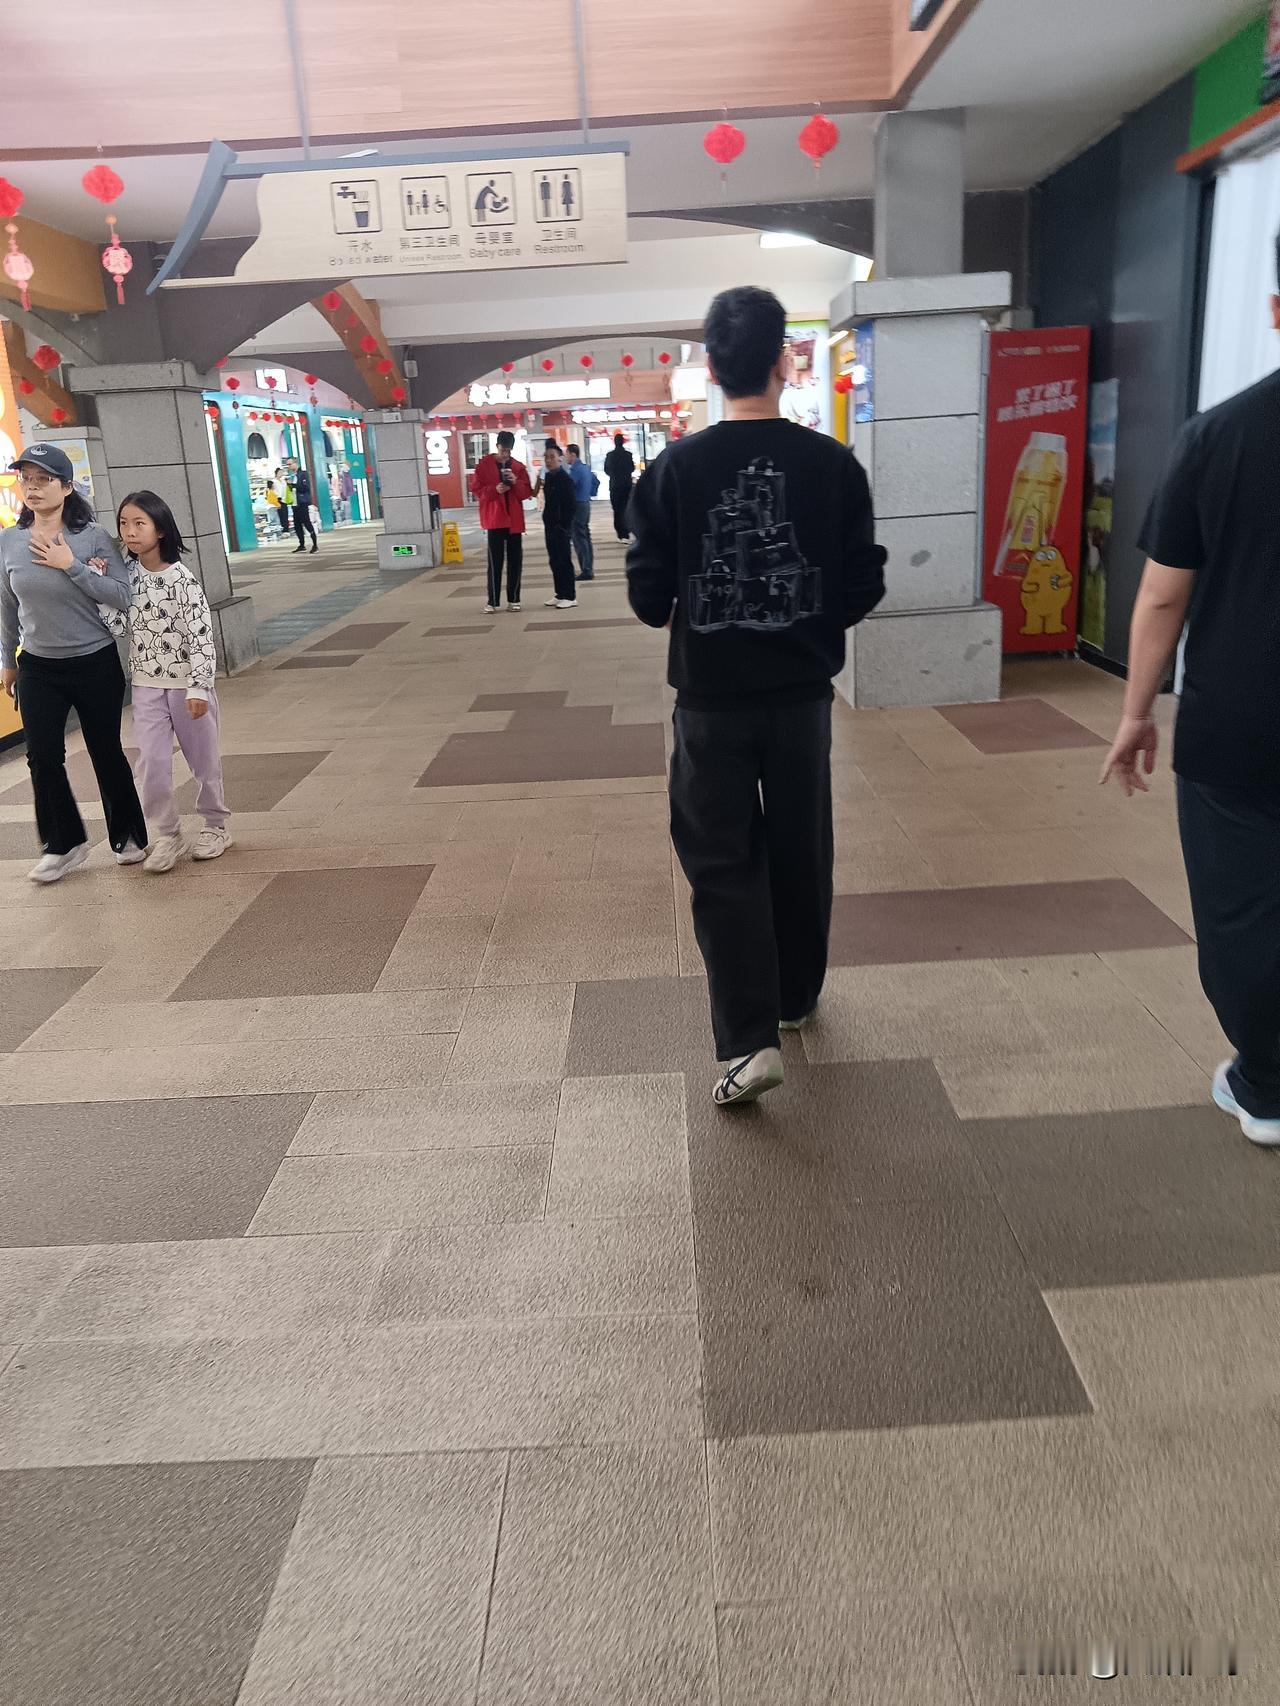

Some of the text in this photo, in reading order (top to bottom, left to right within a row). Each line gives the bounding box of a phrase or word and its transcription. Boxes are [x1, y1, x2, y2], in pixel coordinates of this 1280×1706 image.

[474, 231, 514, 245] 母婴室
[540, 227, 577, 241] 卫生间
[399, 233, 460, 250] 第三卫生间
[469, 247, 522, 259] Baby care
[534, 243, 584, 255] Restroom
